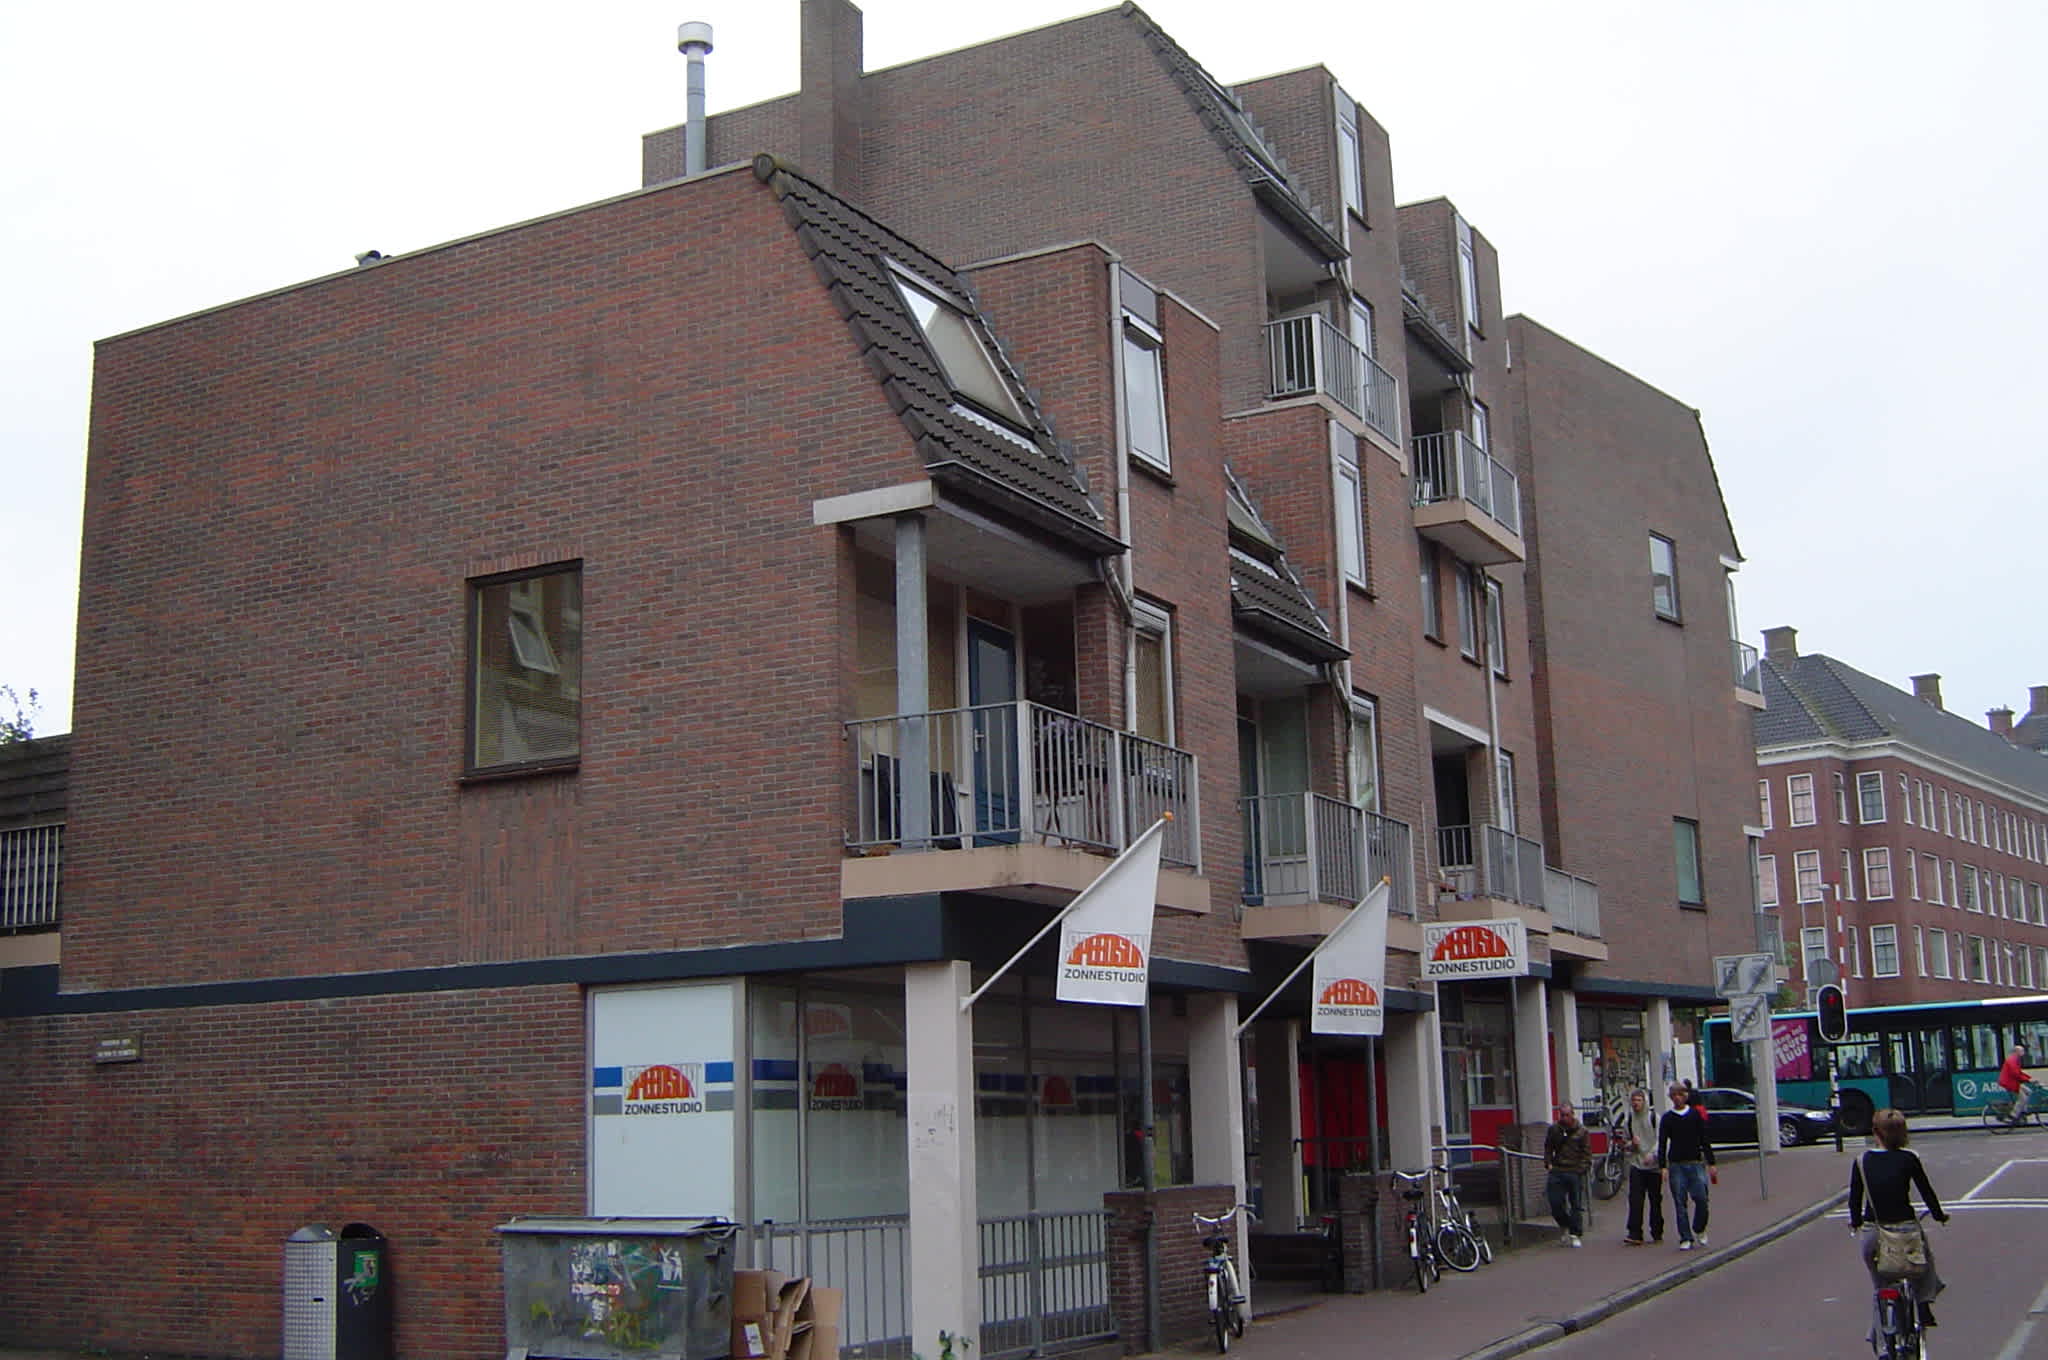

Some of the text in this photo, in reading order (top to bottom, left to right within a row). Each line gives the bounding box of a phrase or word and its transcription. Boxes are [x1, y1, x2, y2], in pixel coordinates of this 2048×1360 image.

[1428, 959, 1516, 975] ZONNESTUDIO
[1064, 968, 1146, 983] ZONNESTUDIO
[1317, 1007, 1381, 1017] ZONNESTUDIO
[624, 1102, 703, 1116] ZONNESTUDIO
